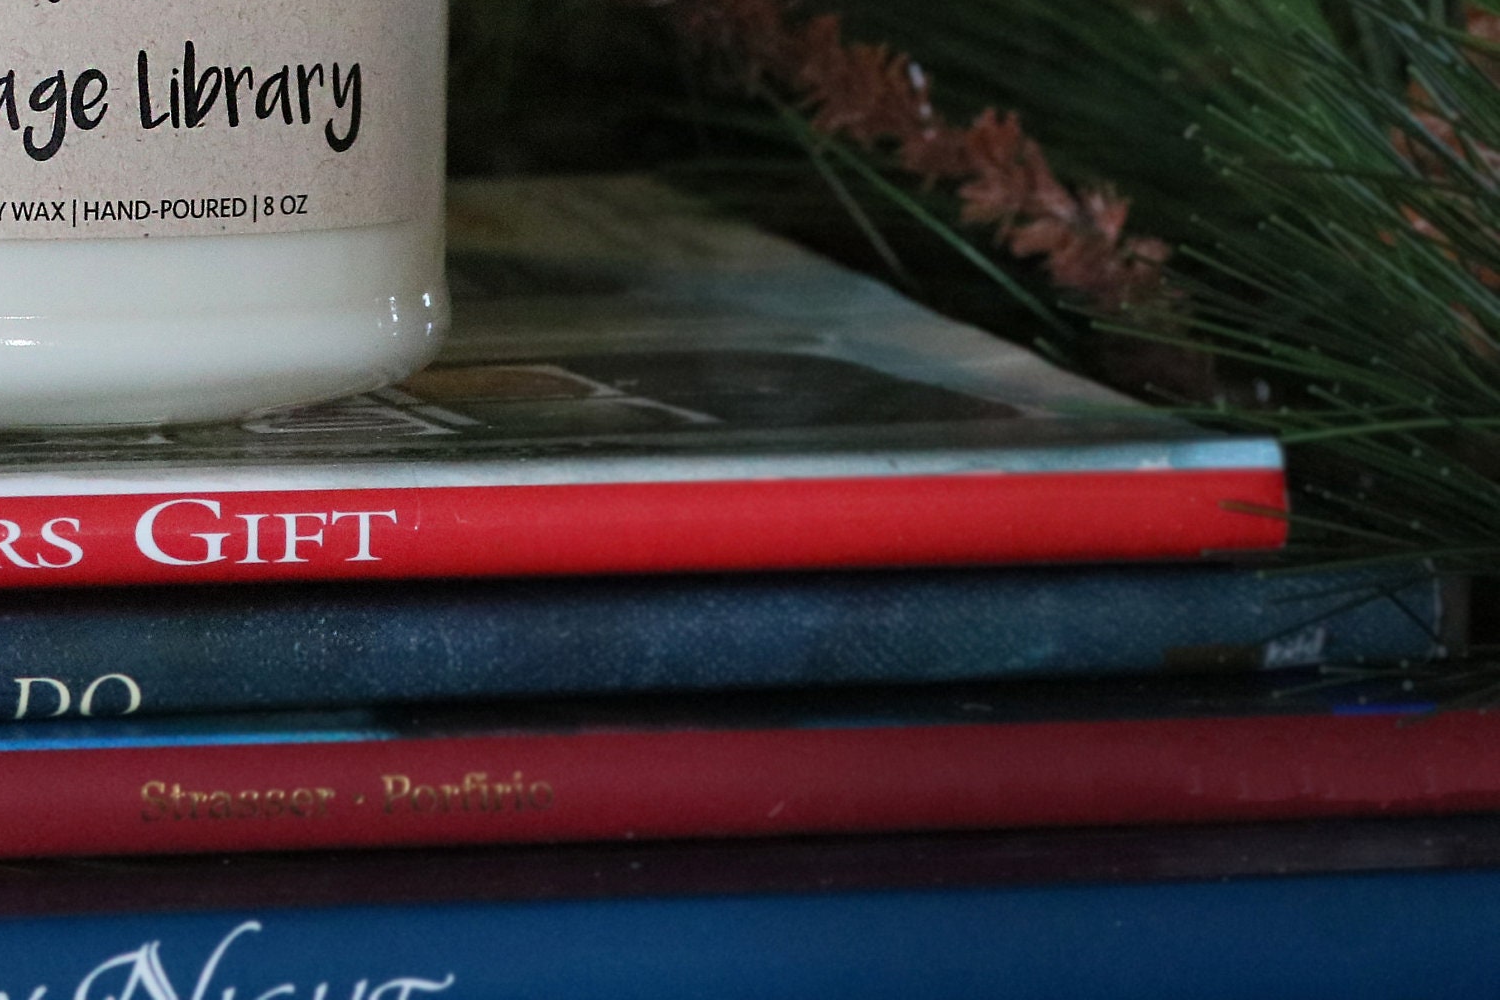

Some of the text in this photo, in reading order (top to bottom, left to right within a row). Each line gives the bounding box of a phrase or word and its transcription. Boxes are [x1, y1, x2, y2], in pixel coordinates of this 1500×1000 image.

[137, 40, 364, 153] Library
[11, 200, 67, 221] WAX
[83, 197, 248, 221] HAND-POURED
[263, 197, 275, 216] 8
[280, 194, 309, 214] OZ
[134, 498, 399, 567] GIFT
